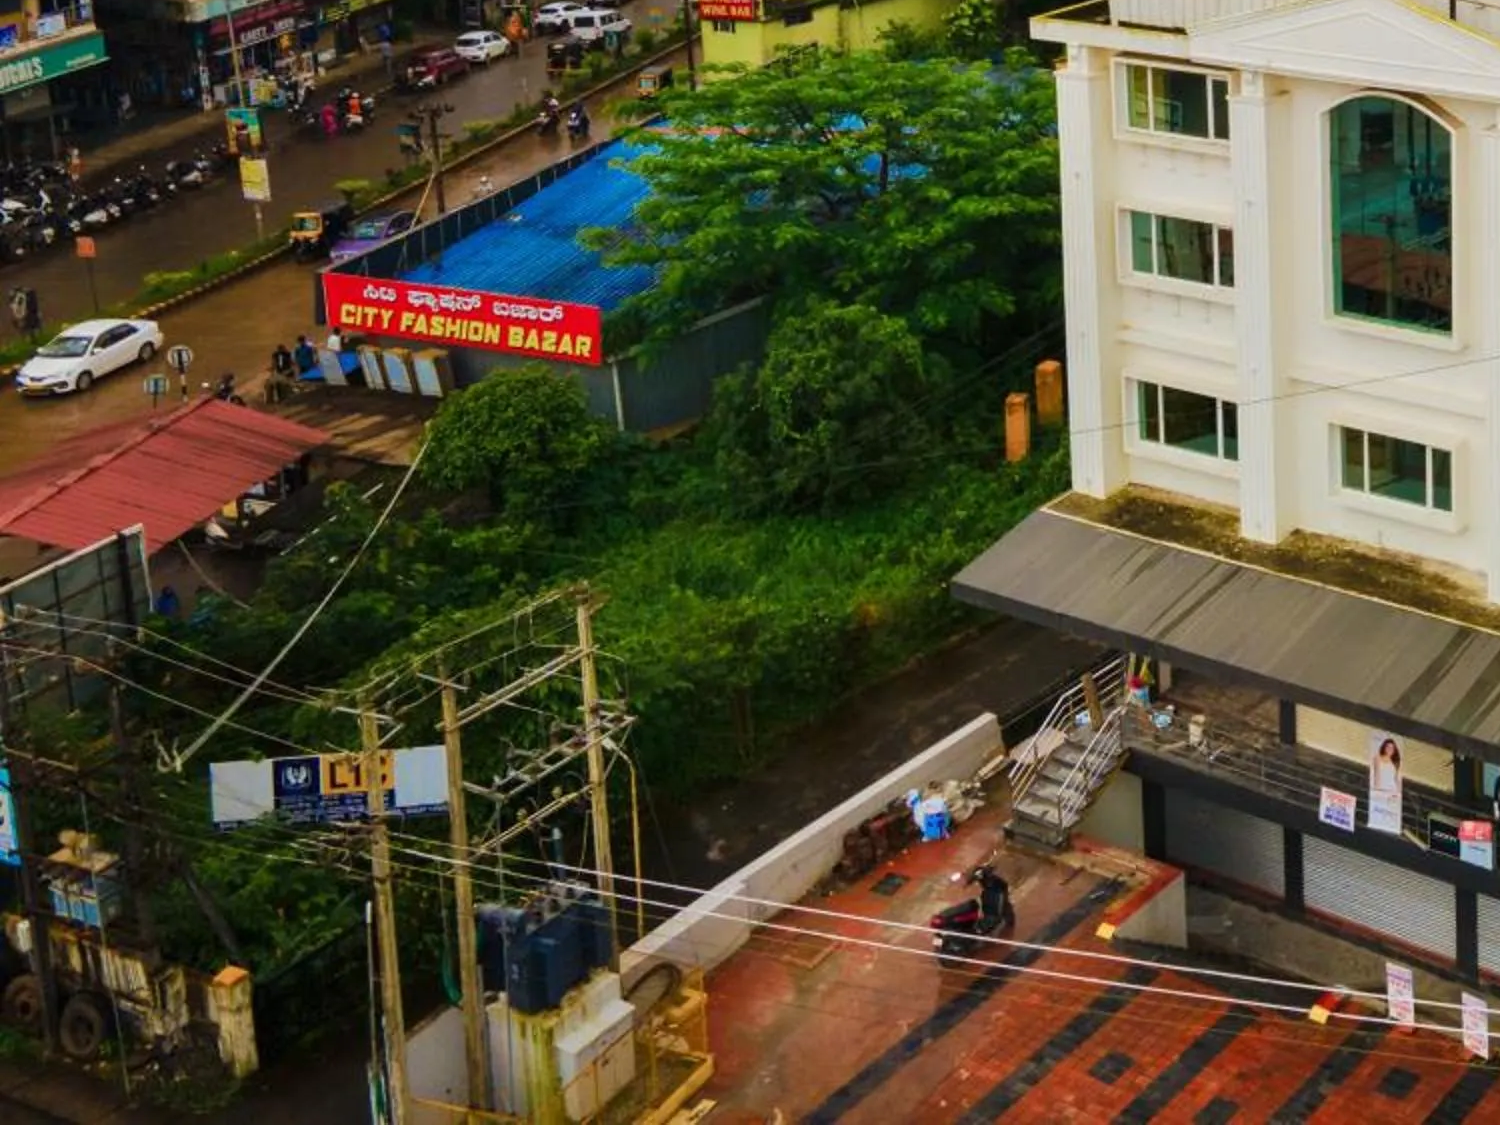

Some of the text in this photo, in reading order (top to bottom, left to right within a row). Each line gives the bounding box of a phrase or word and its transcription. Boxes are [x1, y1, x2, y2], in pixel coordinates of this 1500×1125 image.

[340, 303, 593, 358] CITY FASHION BAZAR
